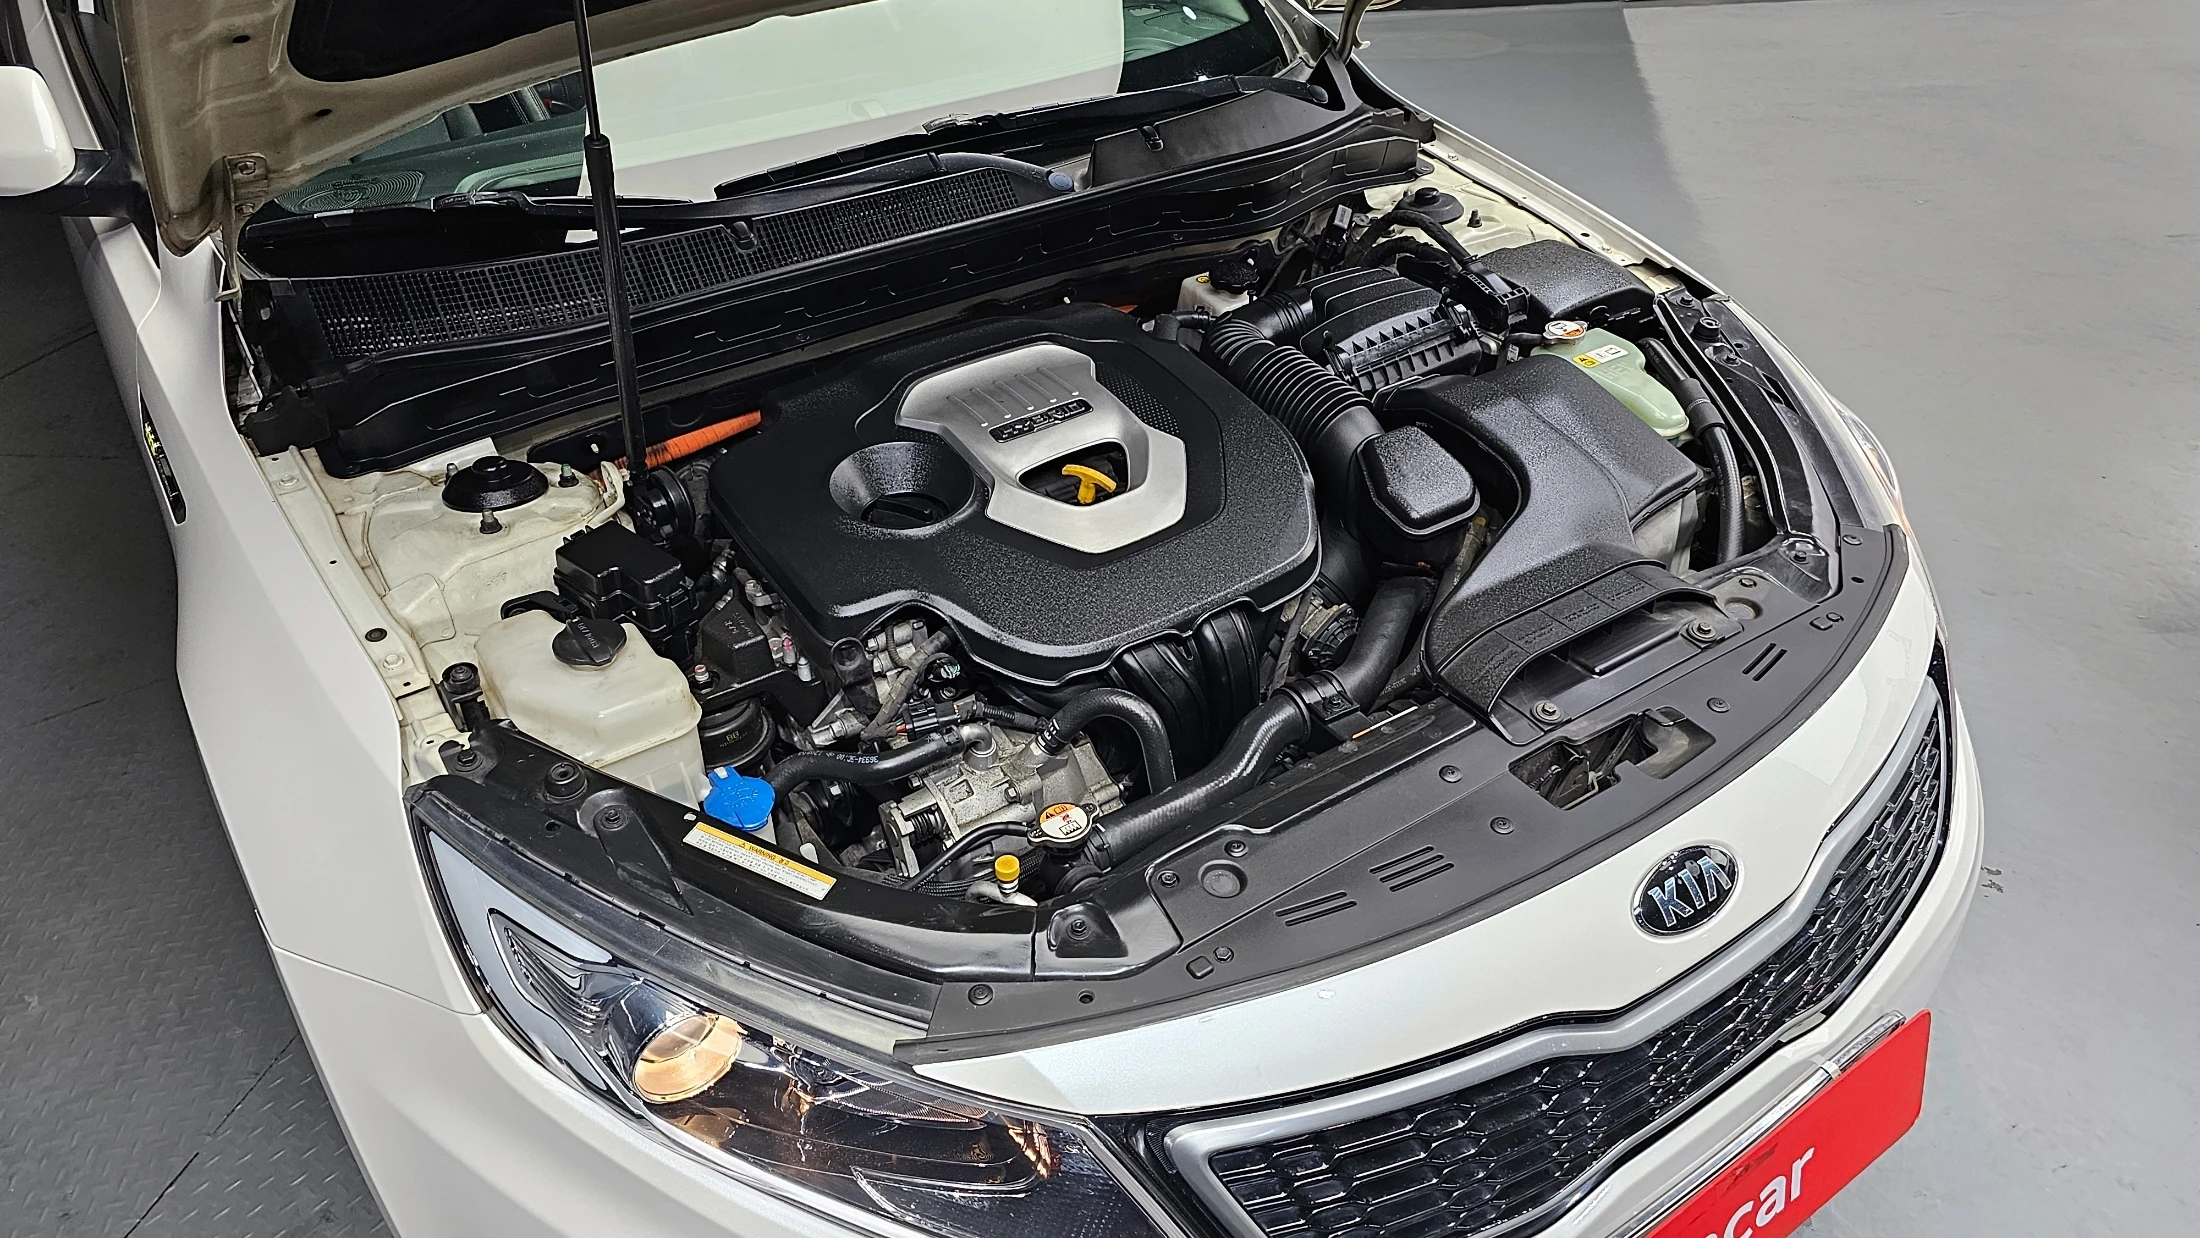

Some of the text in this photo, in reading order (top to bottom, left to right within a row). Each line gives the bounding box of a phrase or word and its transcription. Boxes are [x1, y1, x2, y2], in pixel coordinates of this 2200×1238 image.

[999, 402, 1086, 438] HYBRID
[748, 845, 777, 861] WARNING
[1647, 855, 1732, 928] KIA
[1704, 1146, 1815, 1238] car
